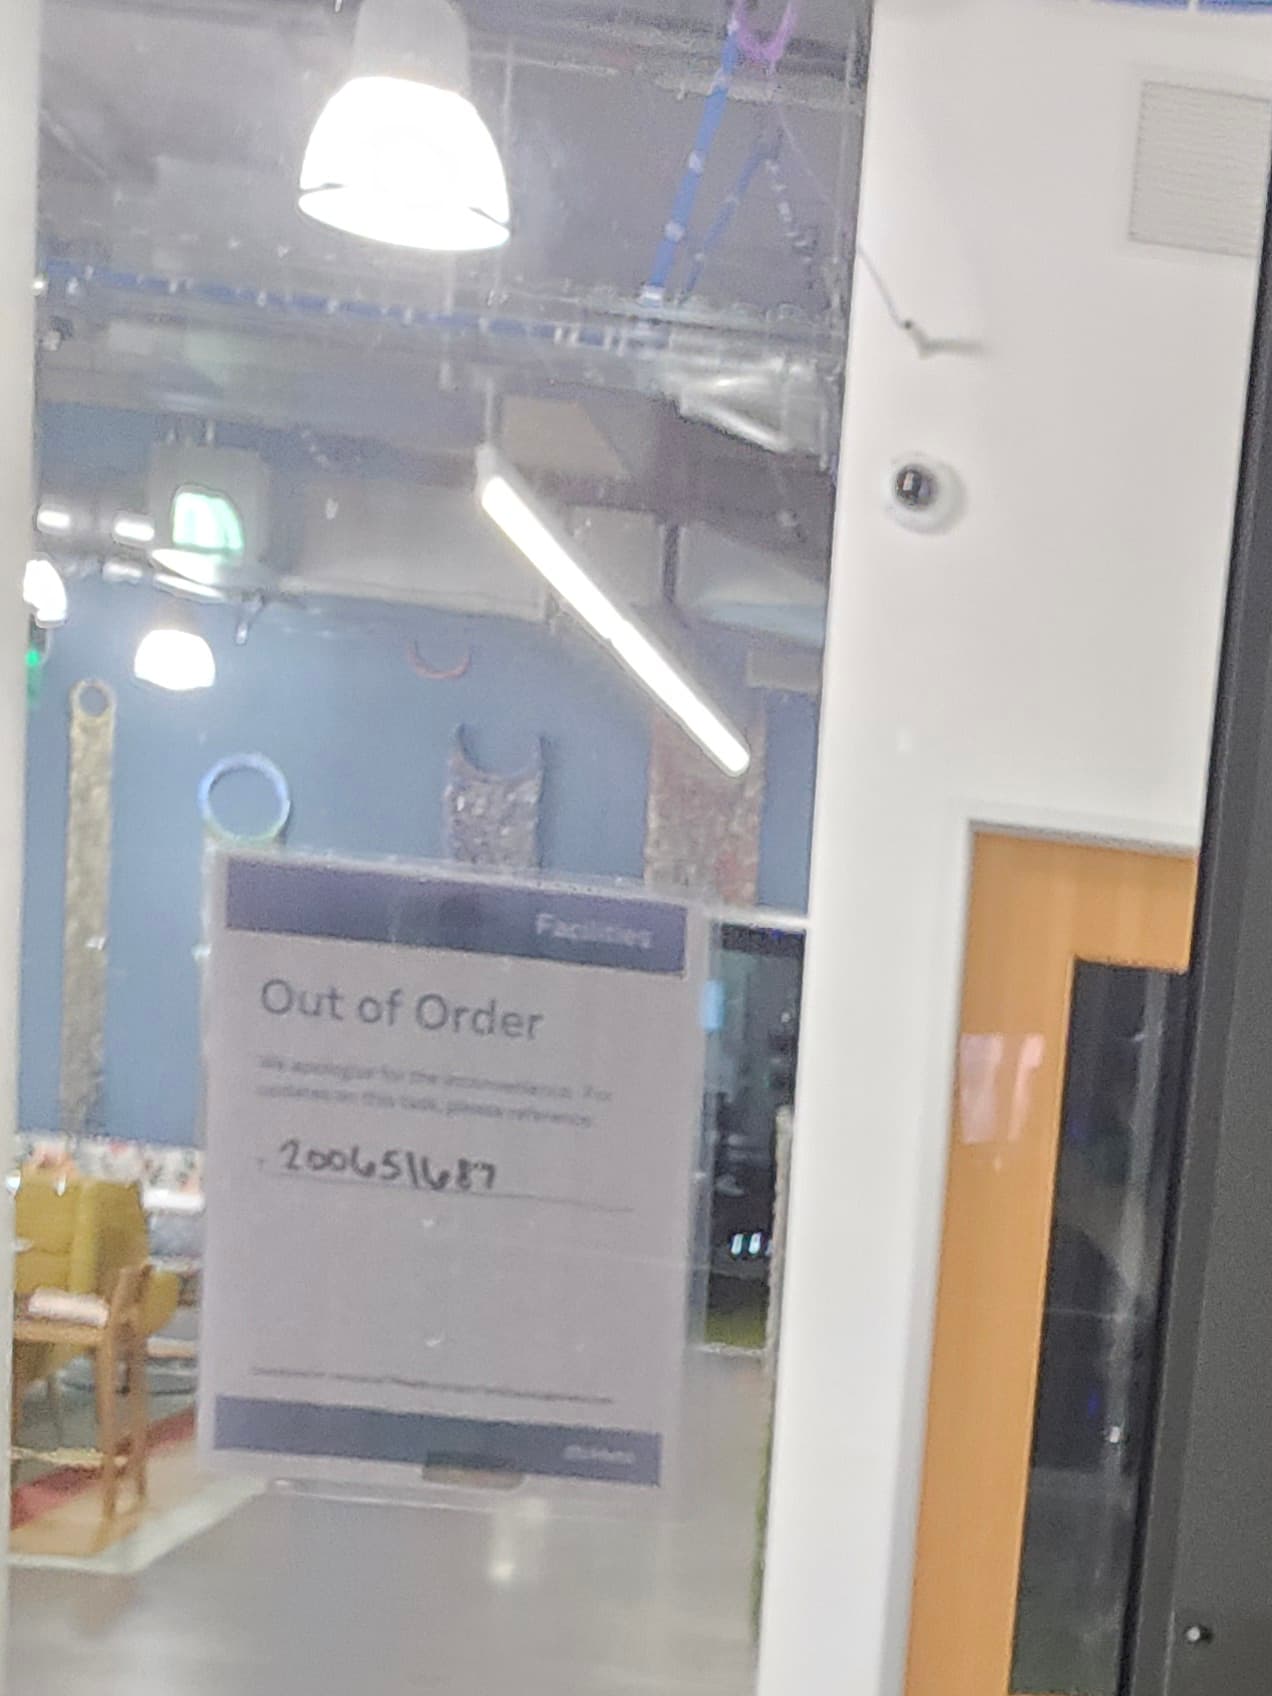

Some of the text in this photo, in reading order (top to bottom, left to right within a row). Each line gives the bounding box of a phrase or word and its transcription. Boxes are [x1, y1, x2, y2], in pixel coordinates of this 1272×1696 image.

[260, 978, 545, 1042] Out of Order
